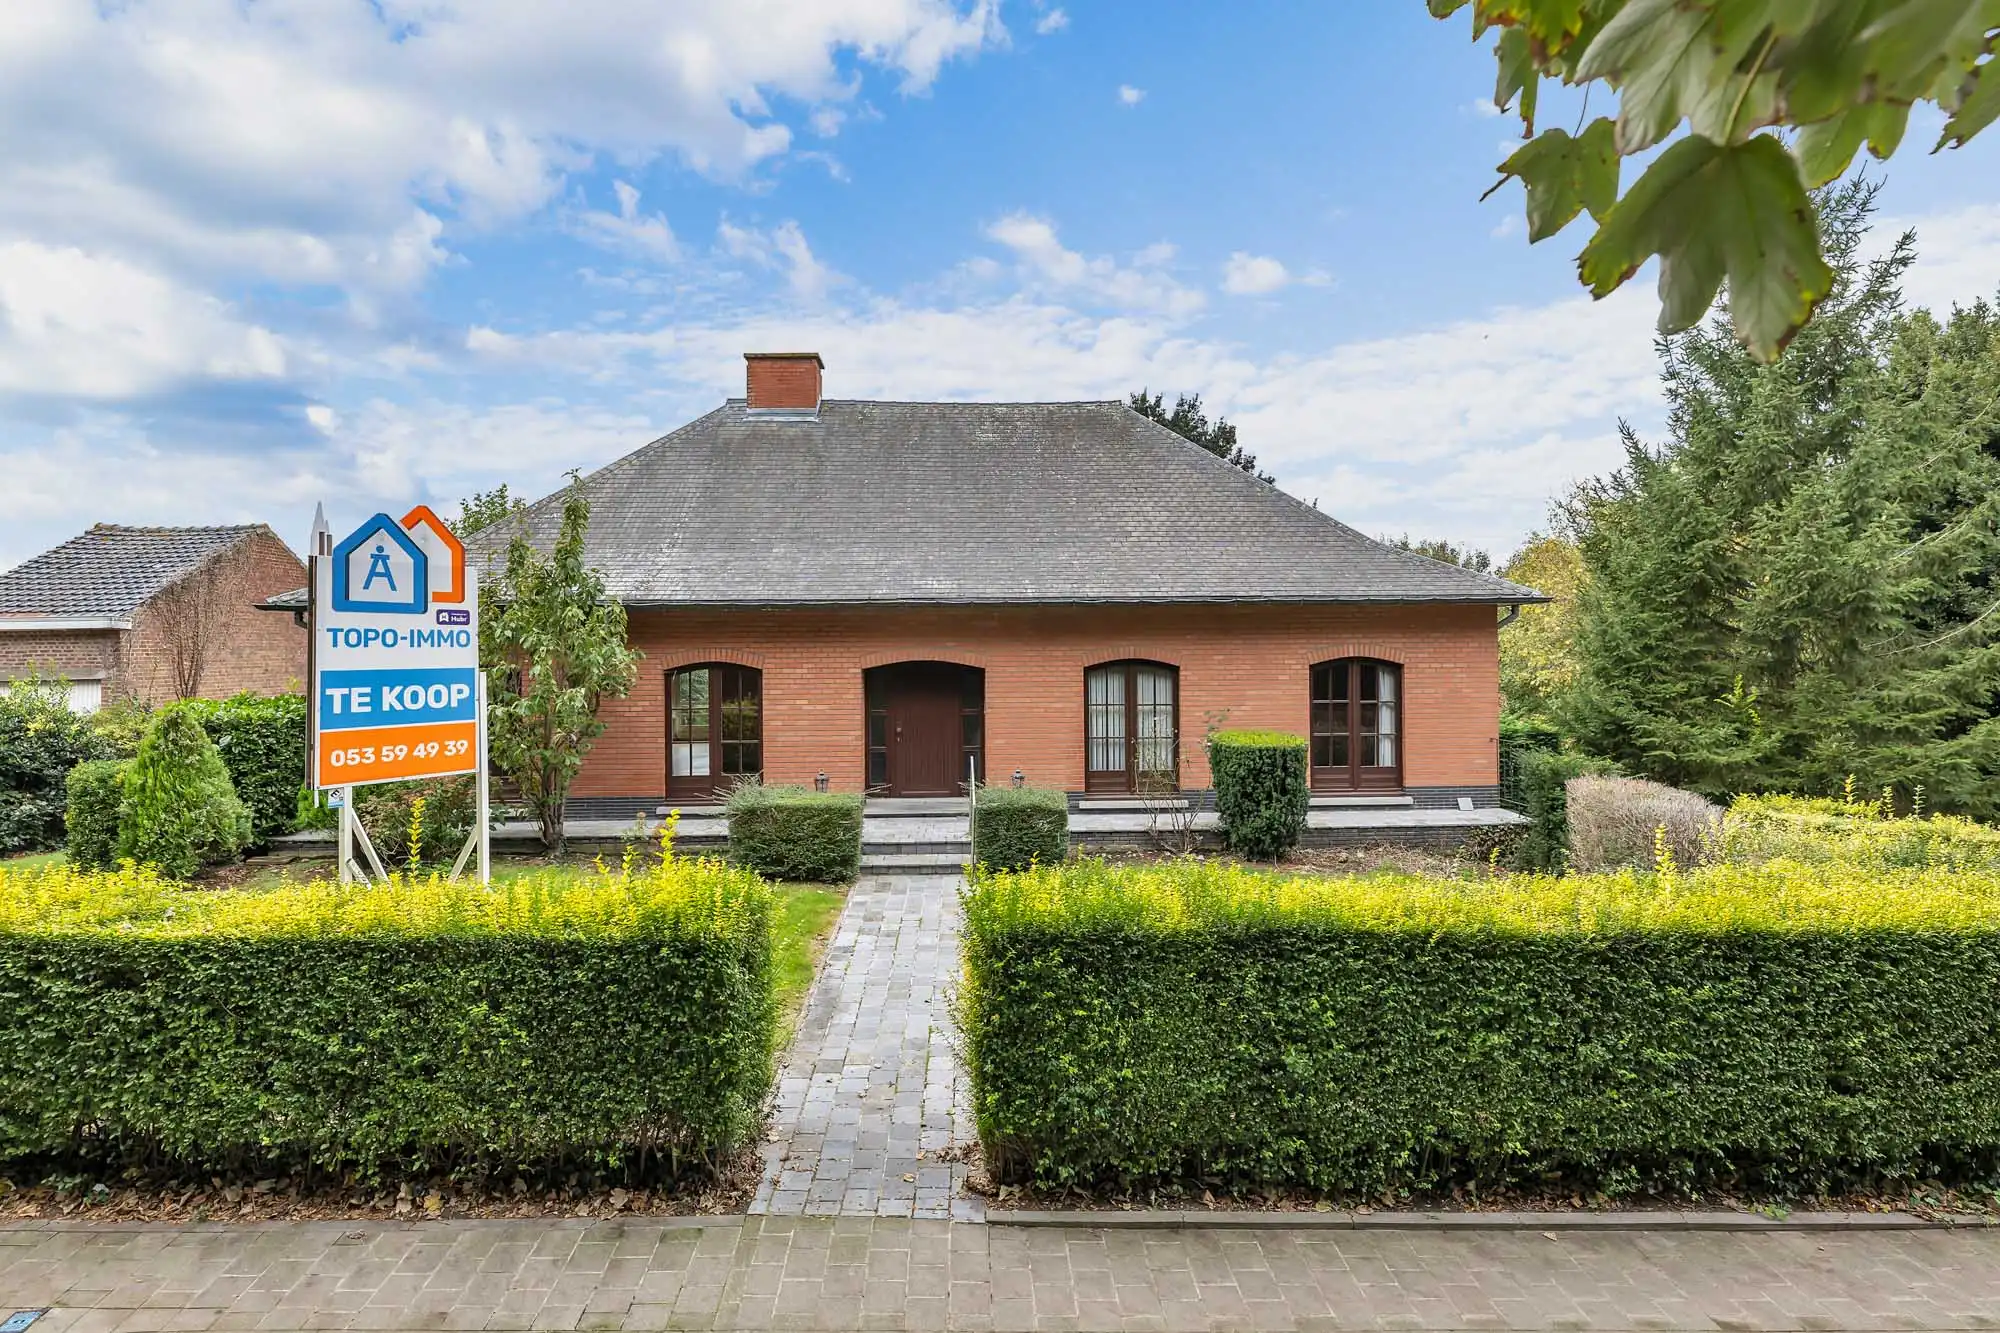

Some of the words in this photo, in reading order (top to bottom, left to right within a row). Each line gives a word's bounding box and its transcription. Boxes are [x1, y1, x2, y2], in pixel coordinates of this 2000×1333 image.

[326, 628, 470, 648] TOPO-IMMO
[325, 687, 372, 714] TE
[382, 683, 470, 711] KOOP
[330, 747, 375, 767] 053
[381, 744, 408, 762] 59
[412, 742, 439, 759] 49
[443, 739, 468, 756] 39
